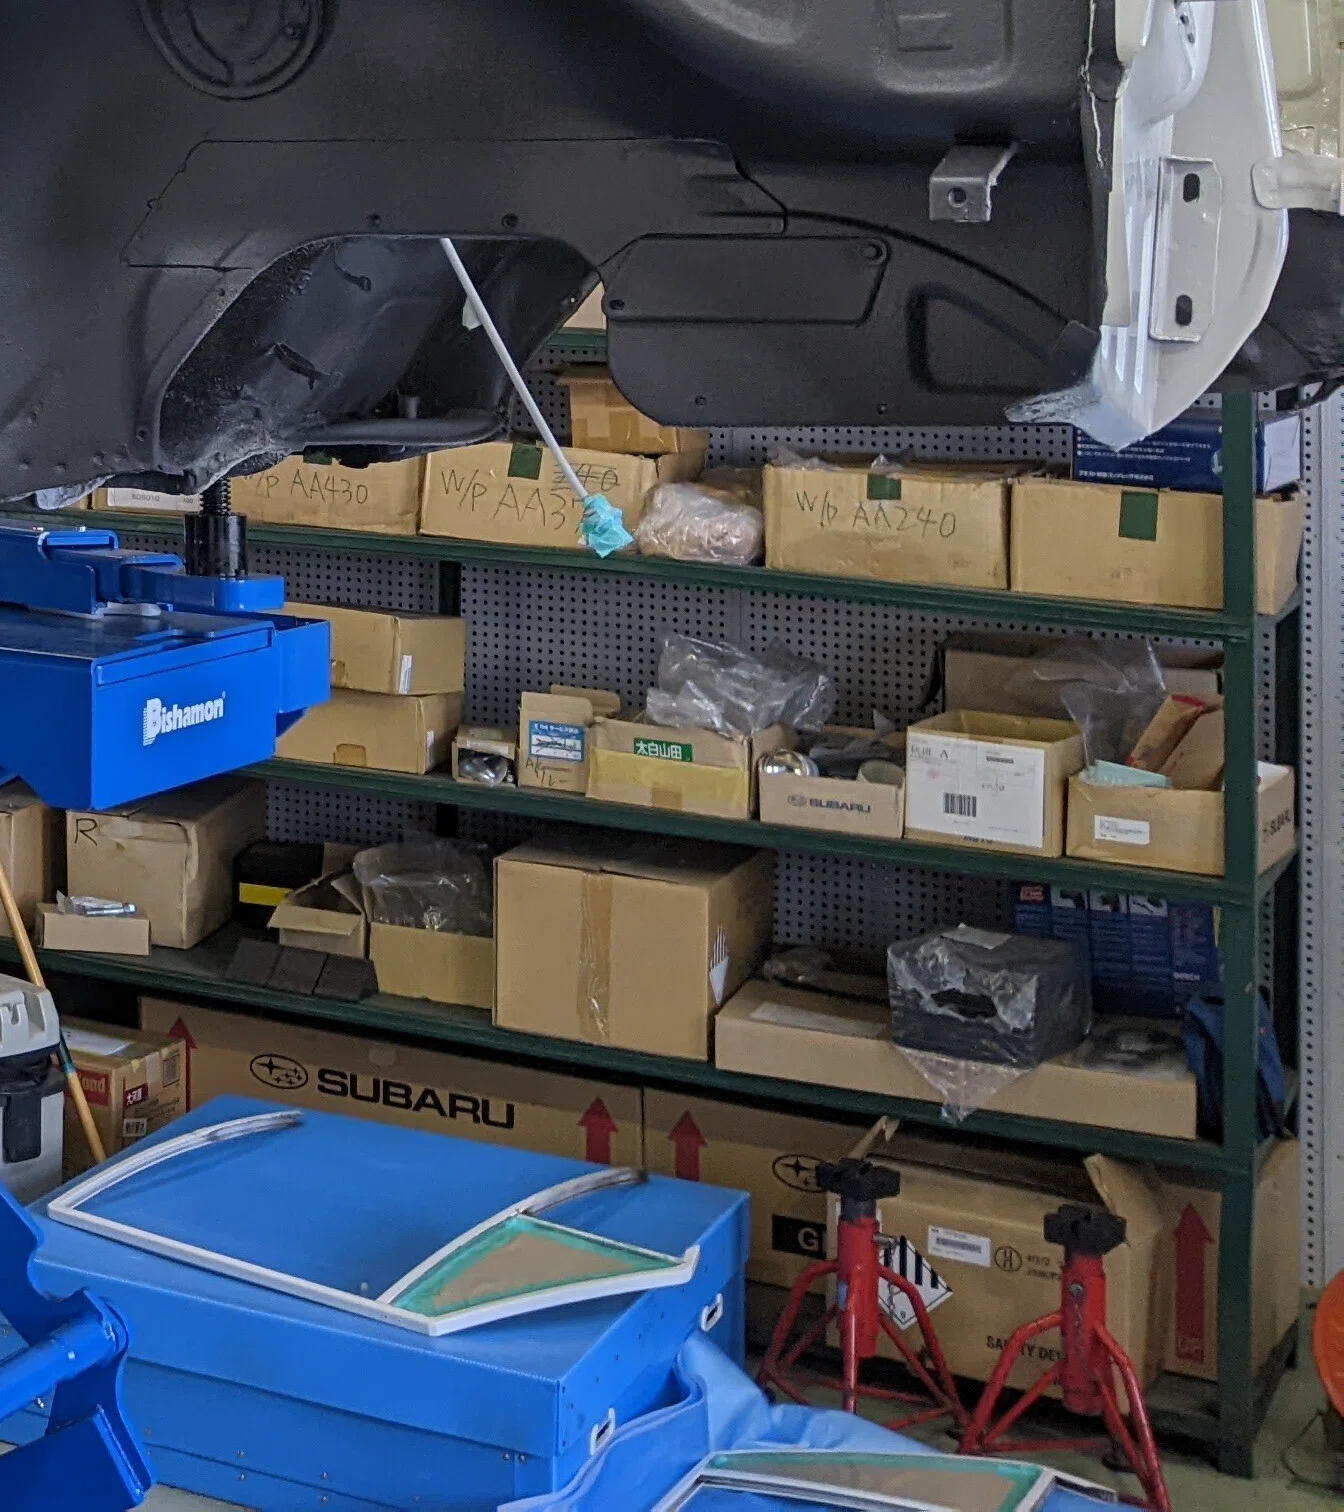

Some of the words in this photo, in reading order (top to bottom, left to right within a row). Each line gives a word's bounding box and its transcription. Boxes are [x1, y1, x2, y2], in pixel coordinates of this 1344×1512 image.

[290, 468, 368, 505] AA430
[441, 469, 487, 512] W/P
[852, 501, 956, 539] AA240
[143, 697, 224, 746] Bishamon
[635, 739, 683, 761] 太白山田
[809, 798, 871, 814] SUBARU
[74, 818, 98, 846] R
[317, 1067, 515, 1129] SUBARU
[986, 1335, 1035, 1358] SATY
